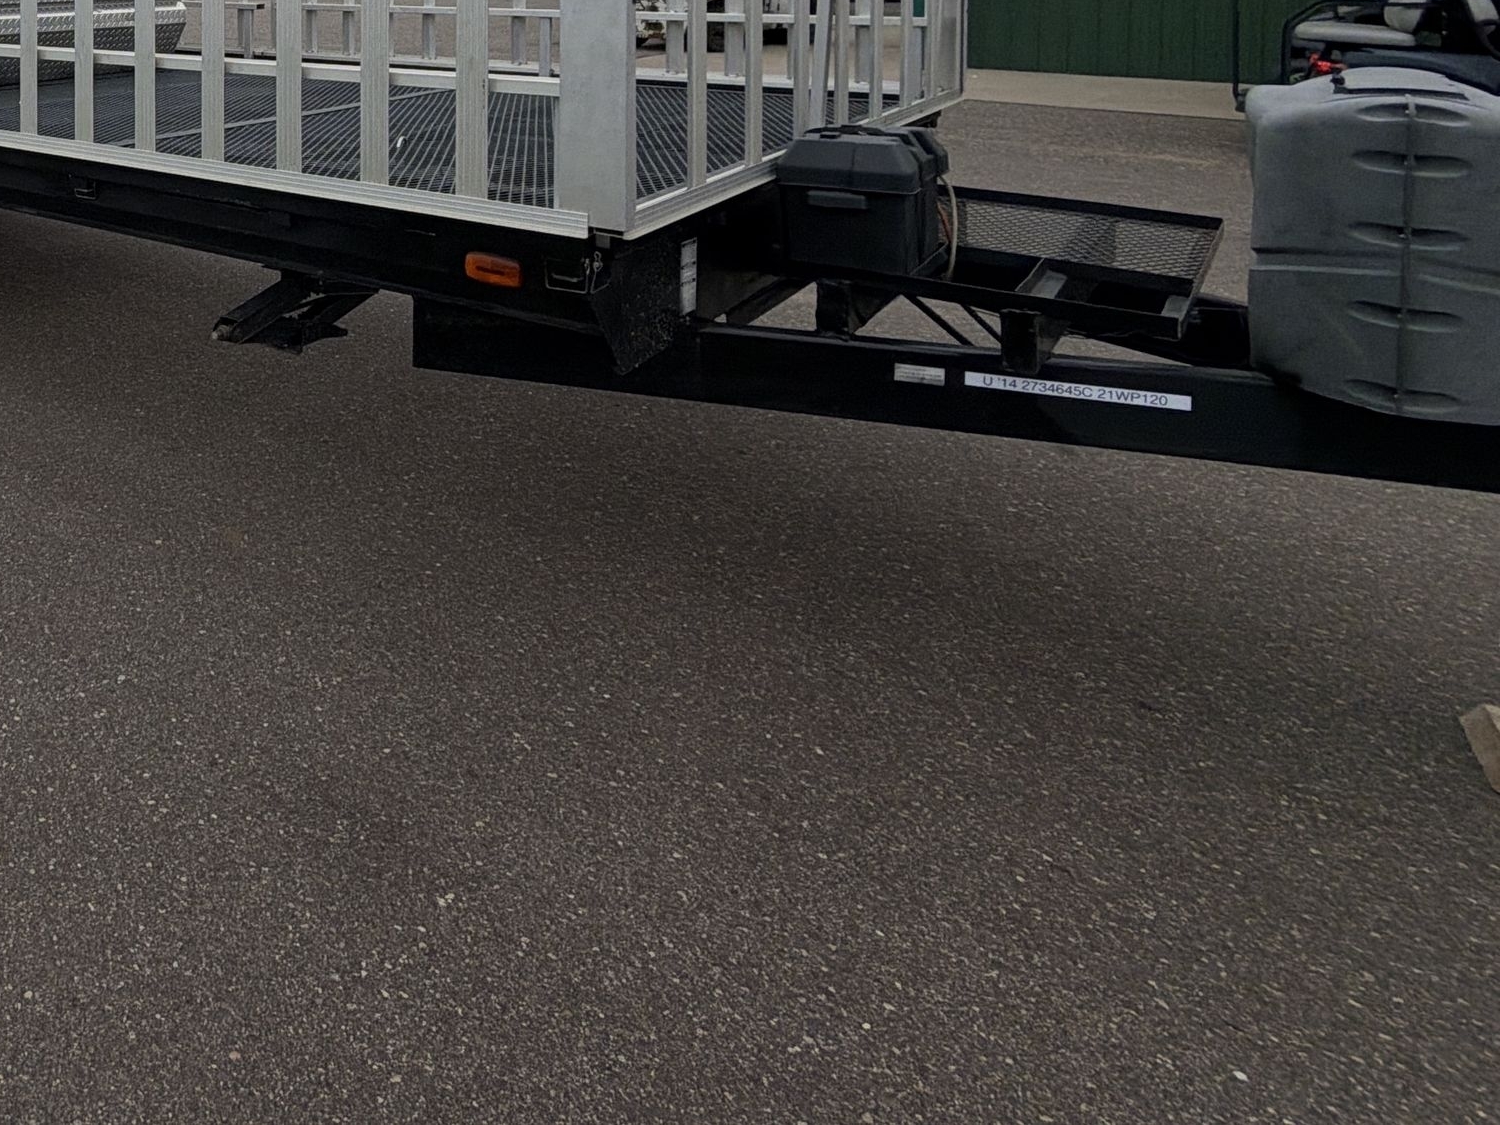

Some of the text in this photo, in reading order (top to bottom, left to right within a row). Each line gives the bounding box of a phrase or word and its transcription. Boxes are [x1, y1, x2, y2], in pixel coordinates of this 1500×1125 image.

[983, 375, 993, 386] U
[1021, 380, 1093, 397] 2734645C
[1097, 389, 1168, 406] 21WP120
